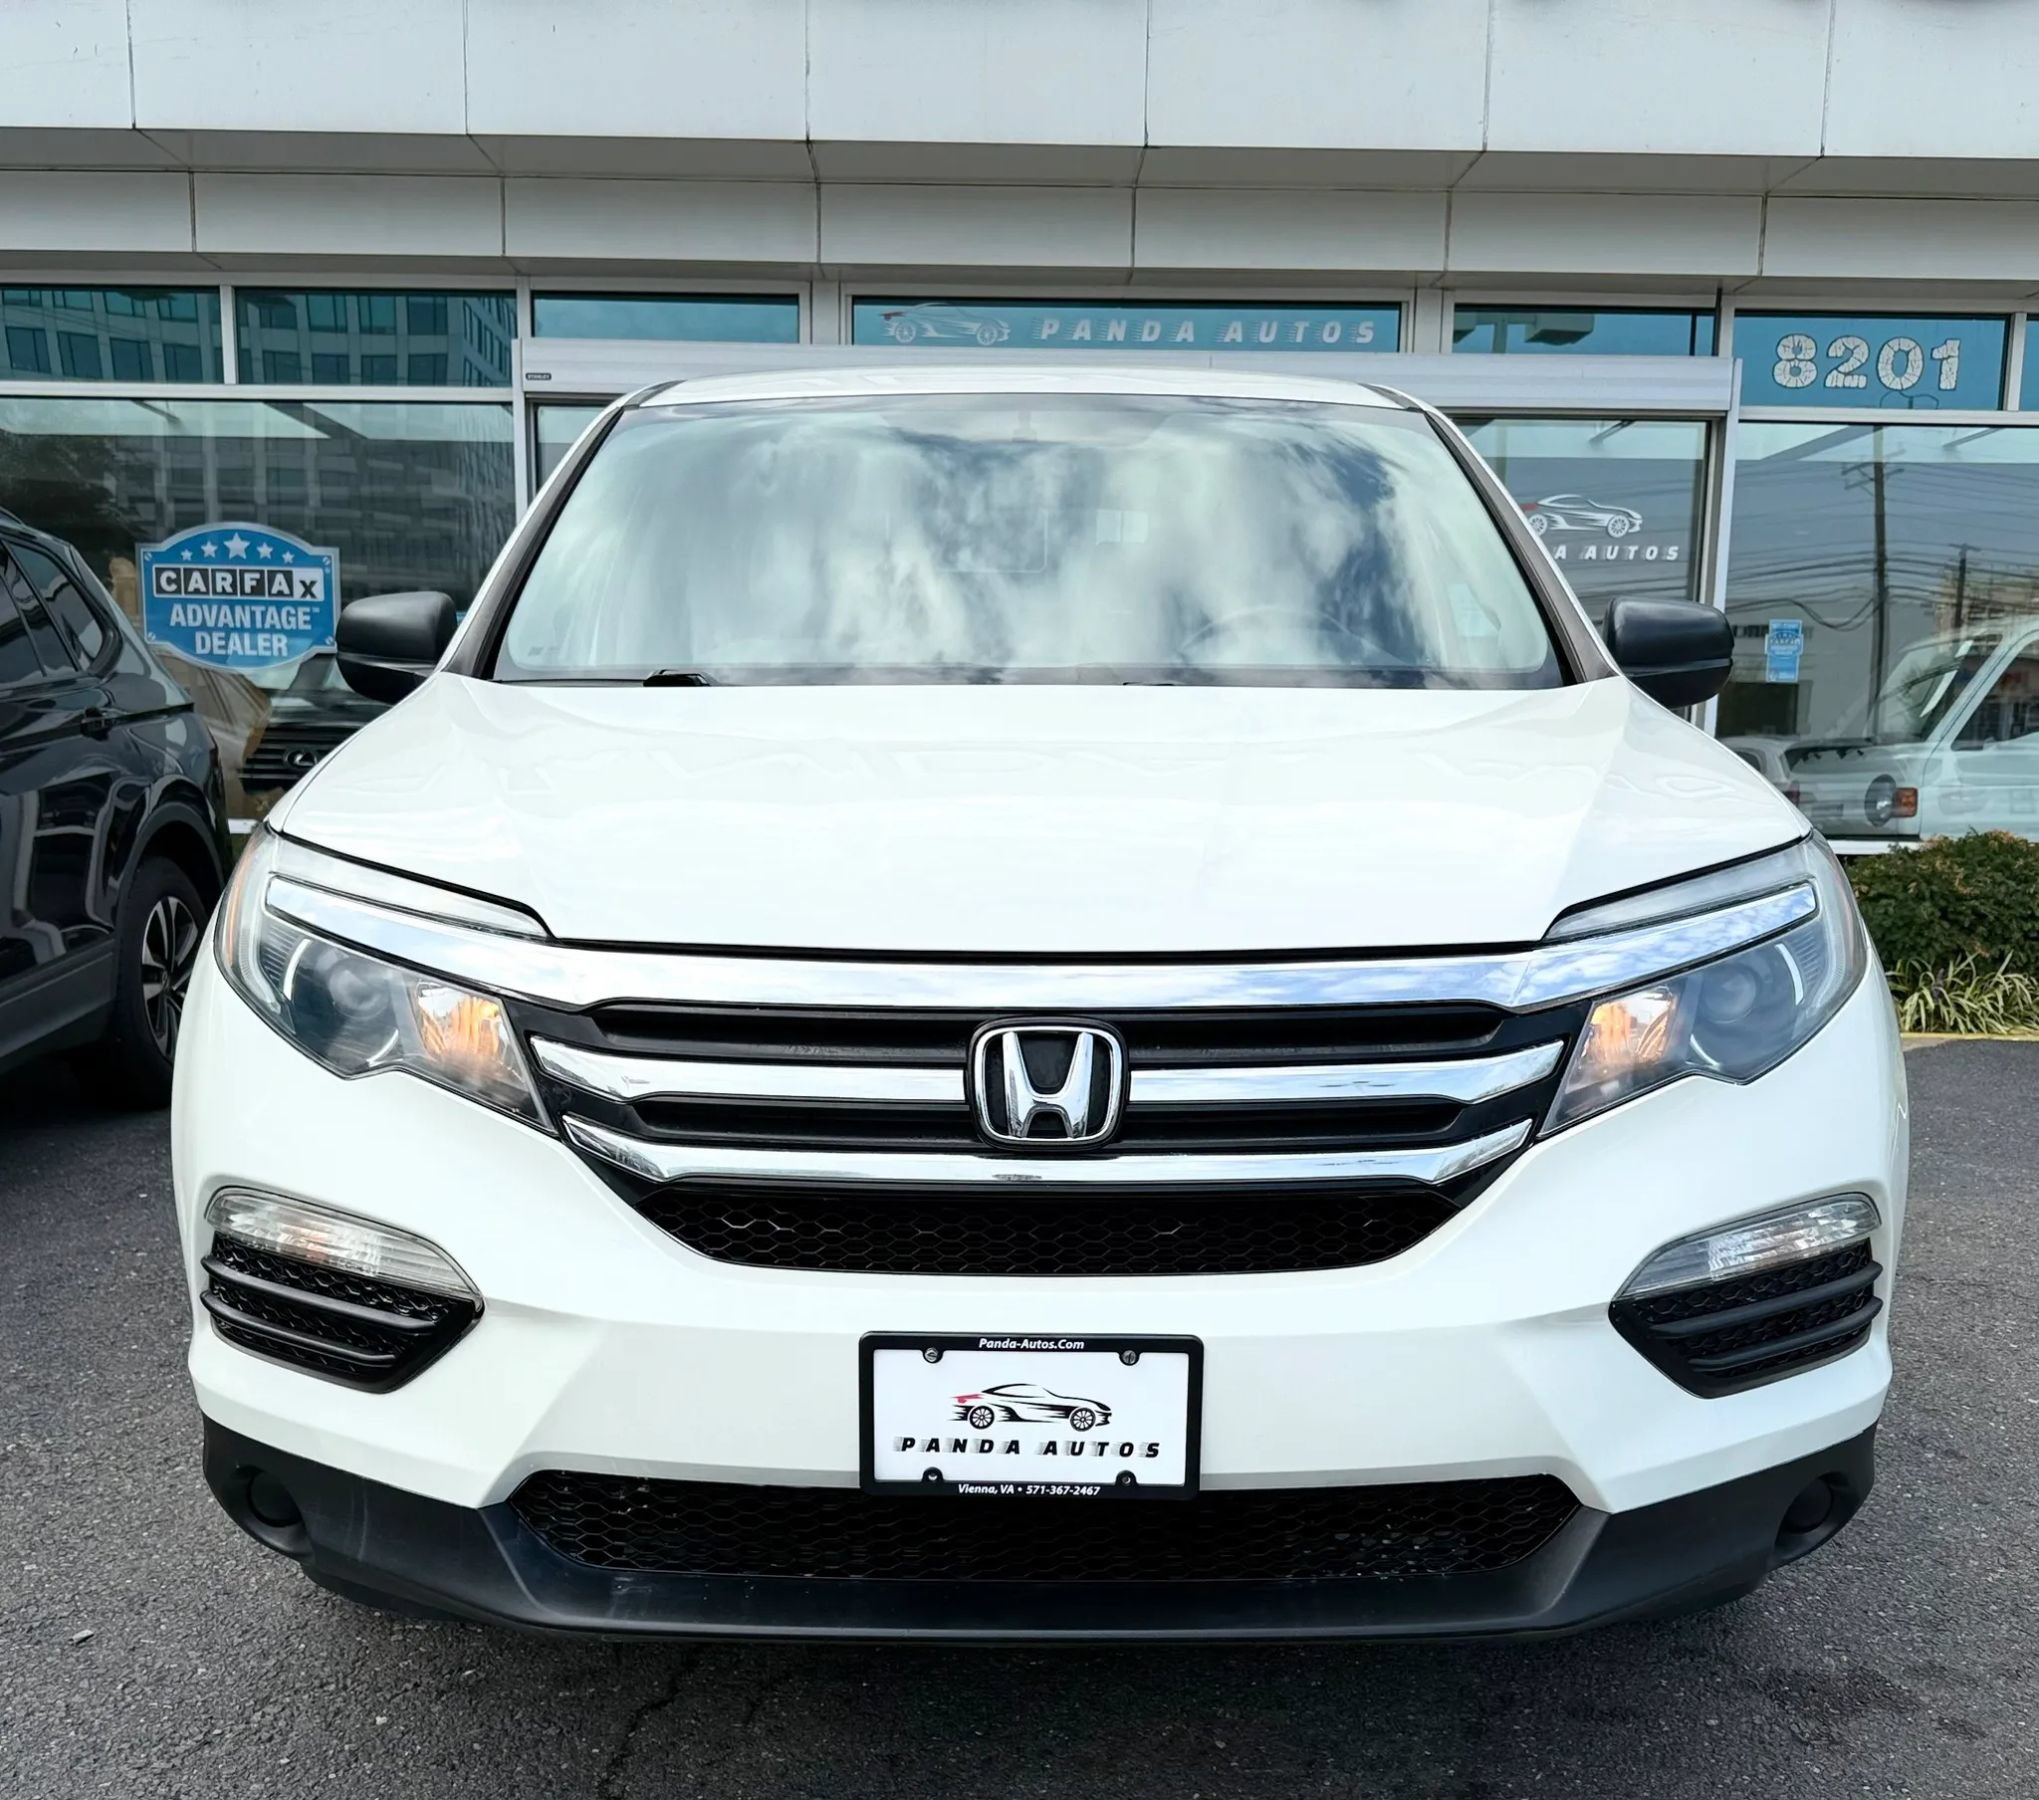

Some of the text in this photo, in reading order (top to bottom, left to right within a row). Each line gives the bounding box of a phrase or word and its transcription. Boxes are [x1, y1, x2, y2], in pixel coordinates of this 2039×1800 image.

[1038, 319, 1375, 344] PANDA AUTOS
[1772, 333, 1961, 391] 8201
[1583, 544, 1680, 561] AUTOS
[195, 632, 288, 657] DEALER
[978, 1337, 1085, 1350] Panda-Autos.Com
[896, 1436, 1161, 1459] PANDA AUTOS
[958, 1483, 1101, 1496] Vienna, VA 571-367-2467
